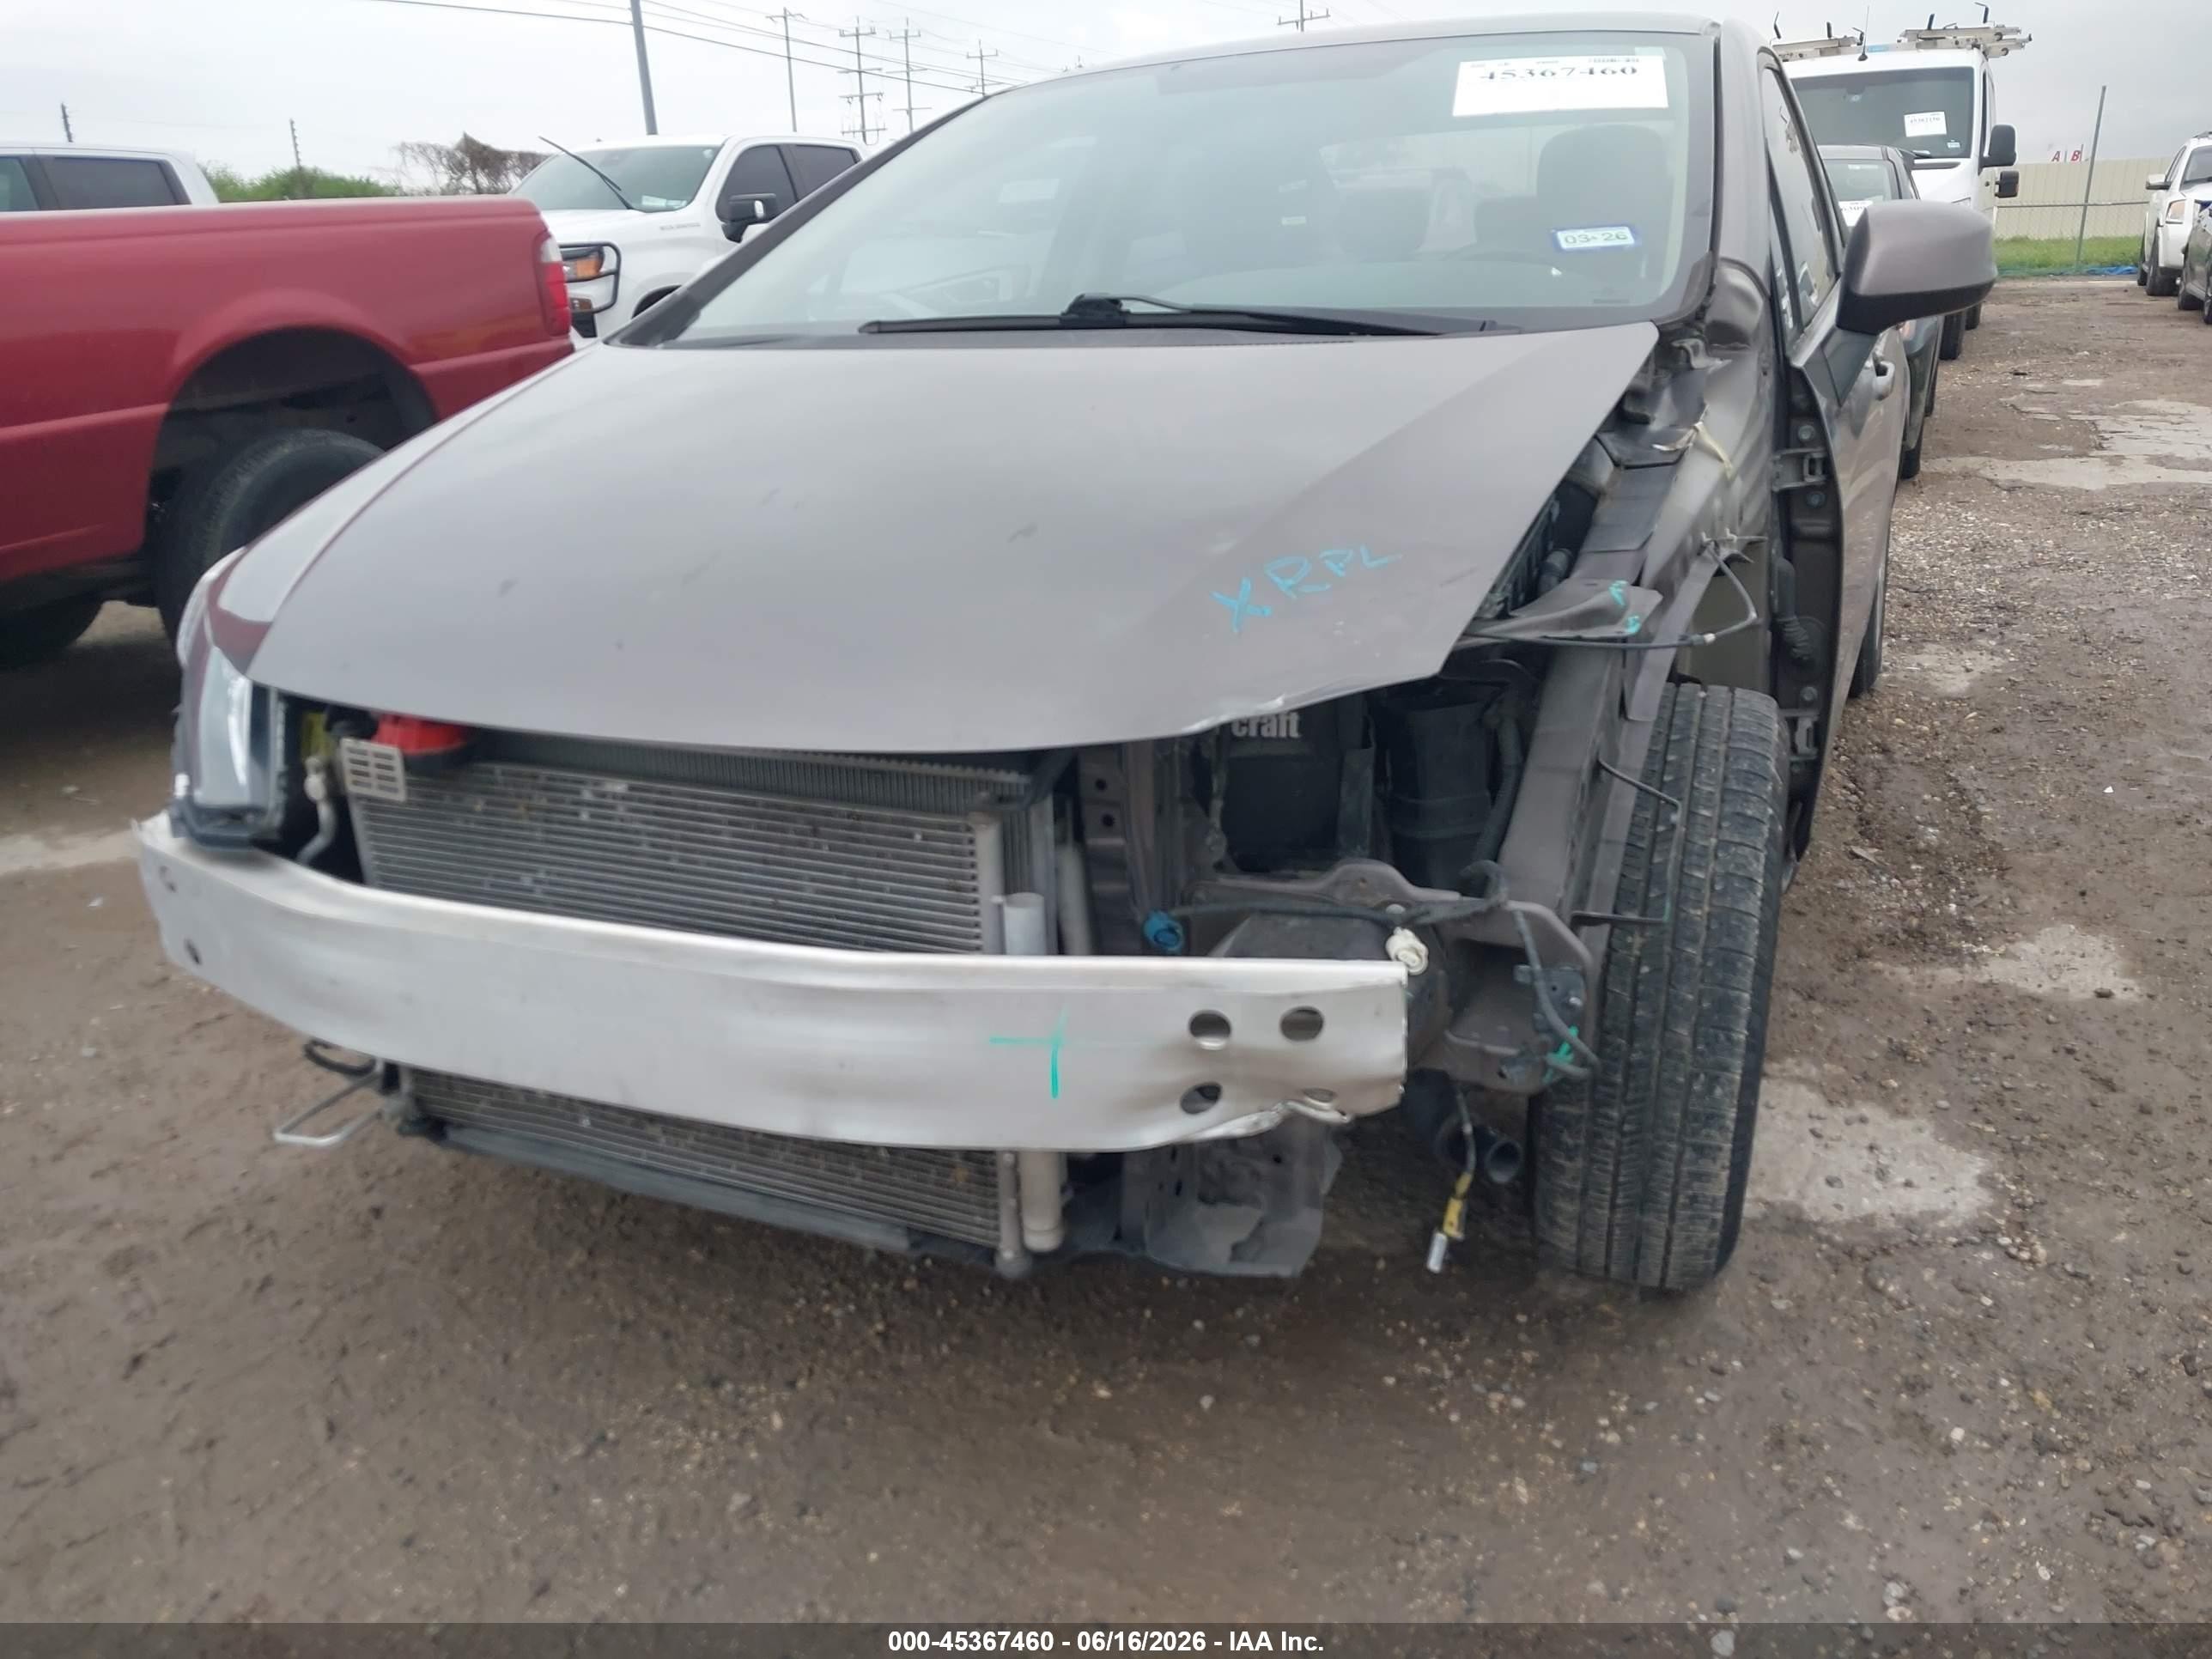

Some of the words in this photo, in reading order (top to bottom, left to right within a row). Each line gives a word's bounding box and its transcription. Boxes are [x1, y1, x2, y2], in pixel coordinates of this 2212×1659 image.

[1479, 66, 1638, 81] 45367460
[2051, 150, 2061, 162] A
[2070, 149, 2081, 161] B
